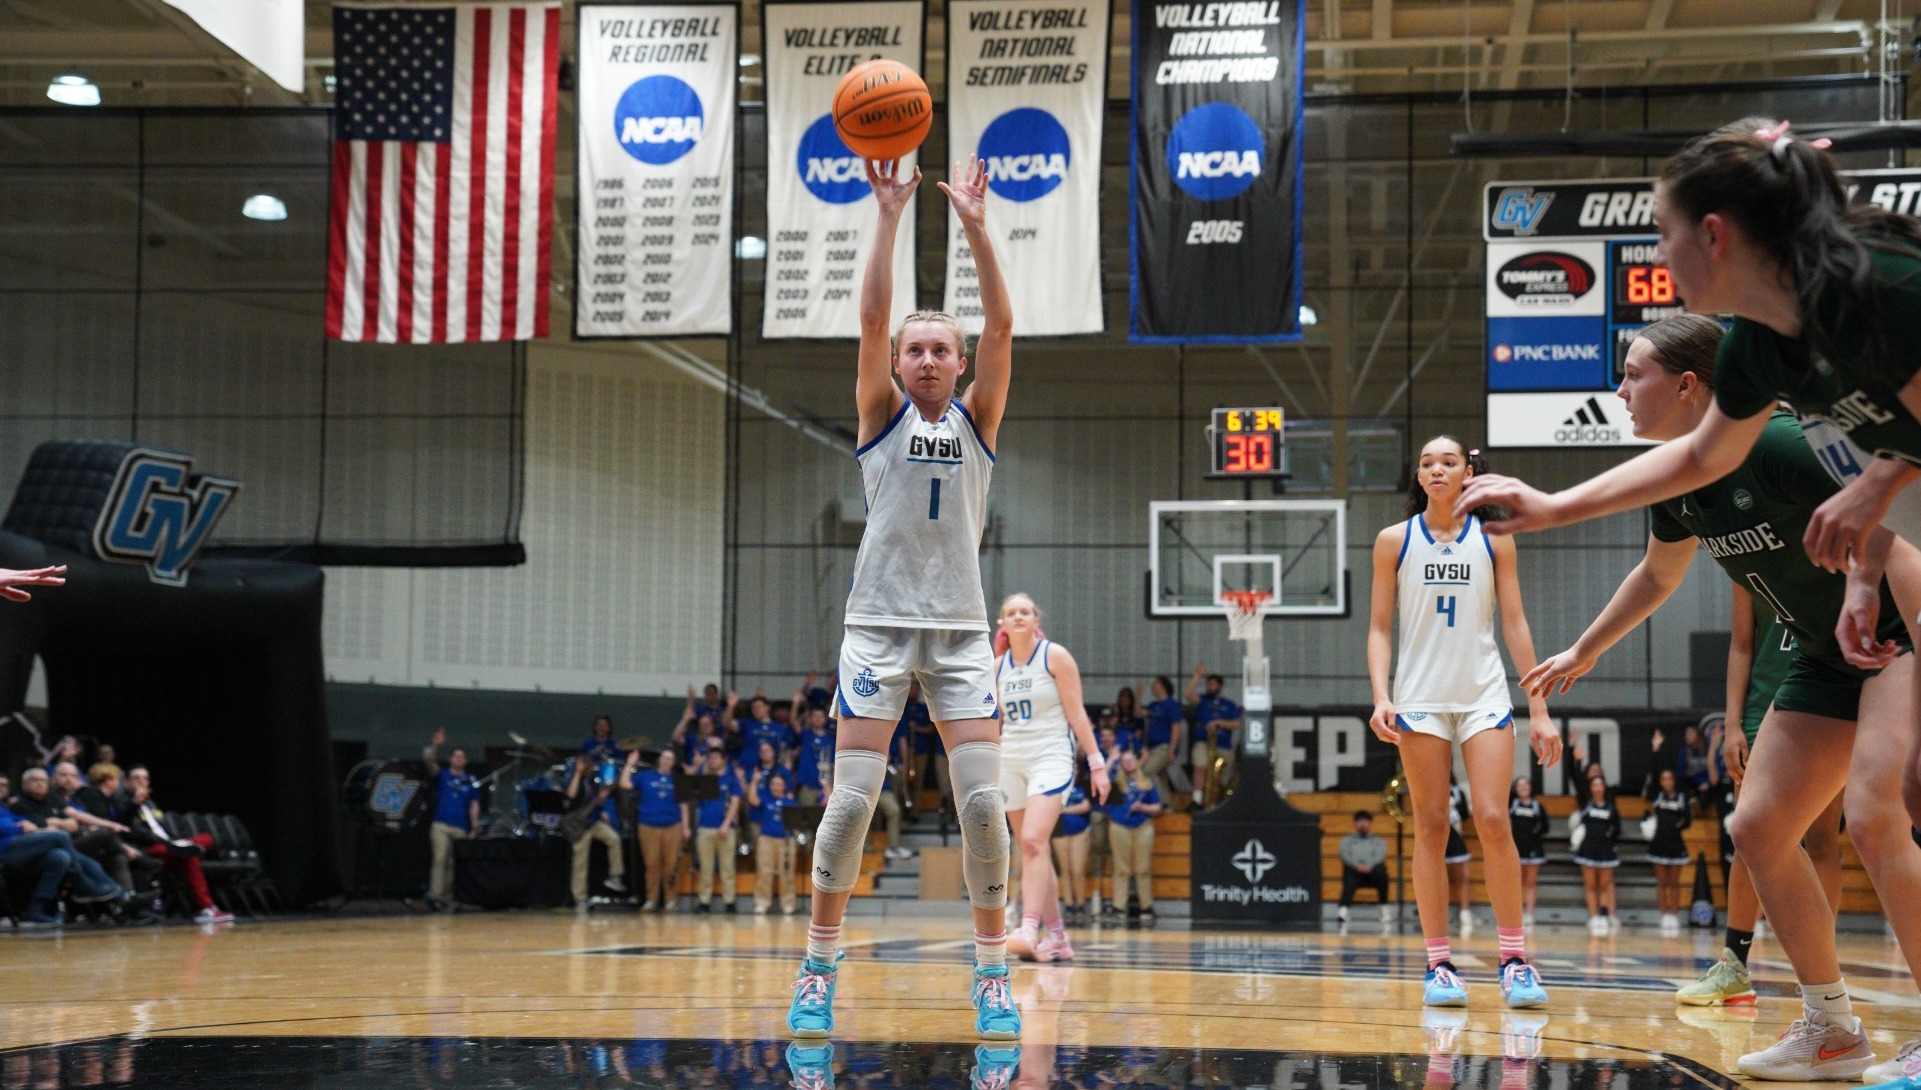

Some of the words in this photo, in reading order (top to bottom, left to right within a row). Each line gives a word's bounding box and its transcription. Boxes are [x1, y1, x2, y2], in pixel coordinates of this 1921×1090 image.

[599, 17, 720, 38] VOLLEYBALL
[968, 7, 1087, 31] VOLLEYBALL
[1155, 1, 1280, 28] VOLLEYBALL
[784, 25, 903, 48] VOLLEYBALL
[979, 35, 1076, 59] NATIONAL
[1169, 29, 1267, 56] NATIONAL
[608, 43, 709, 64] REGIONAL
[965, 62, 1088, 88] SEMIFINALS
[1155, 57, 1280, 85] CHAMPIONS
[621, 116, 702, 144] NCAA
[806, 157, 870, 183] NCA
[985, 153, 1069, 181] NCAA
[1177, 150, 1261, 179] NCAA
[1491, 187, 1556, 236] GV
[1579, 191, 1659, 227] GRA
[1871, 182, 1921, 217] ST
[1186, 220, 1244, 244] 2005
[1621, 246, 1658, 263] HOM
[1502, 270, 1566, 284] TOMMY'S
[1628, 267, 1675, 303] 68
[909, 434, 963, 459] GVSU
[1554, 427, 1621, 442] adidas
[1224, 435, 1272, 472] 30
[929, 478, 941, 520] 1
[93, 448, 243, 588] GV
[1700, 521, 1786, 558] ARKSIDE
[1424, 563, 1471, 581] GVSU
[1746, 573, 1795, 622] 1
[1436, 595, 1456, 627] 4
[1004, 679, 1032, 693] GVSU
[1006, 699, 1032, 722] 20
[1201, 884, 1252, 906] Trinity
[1253, 885, 1310, 902] Health
